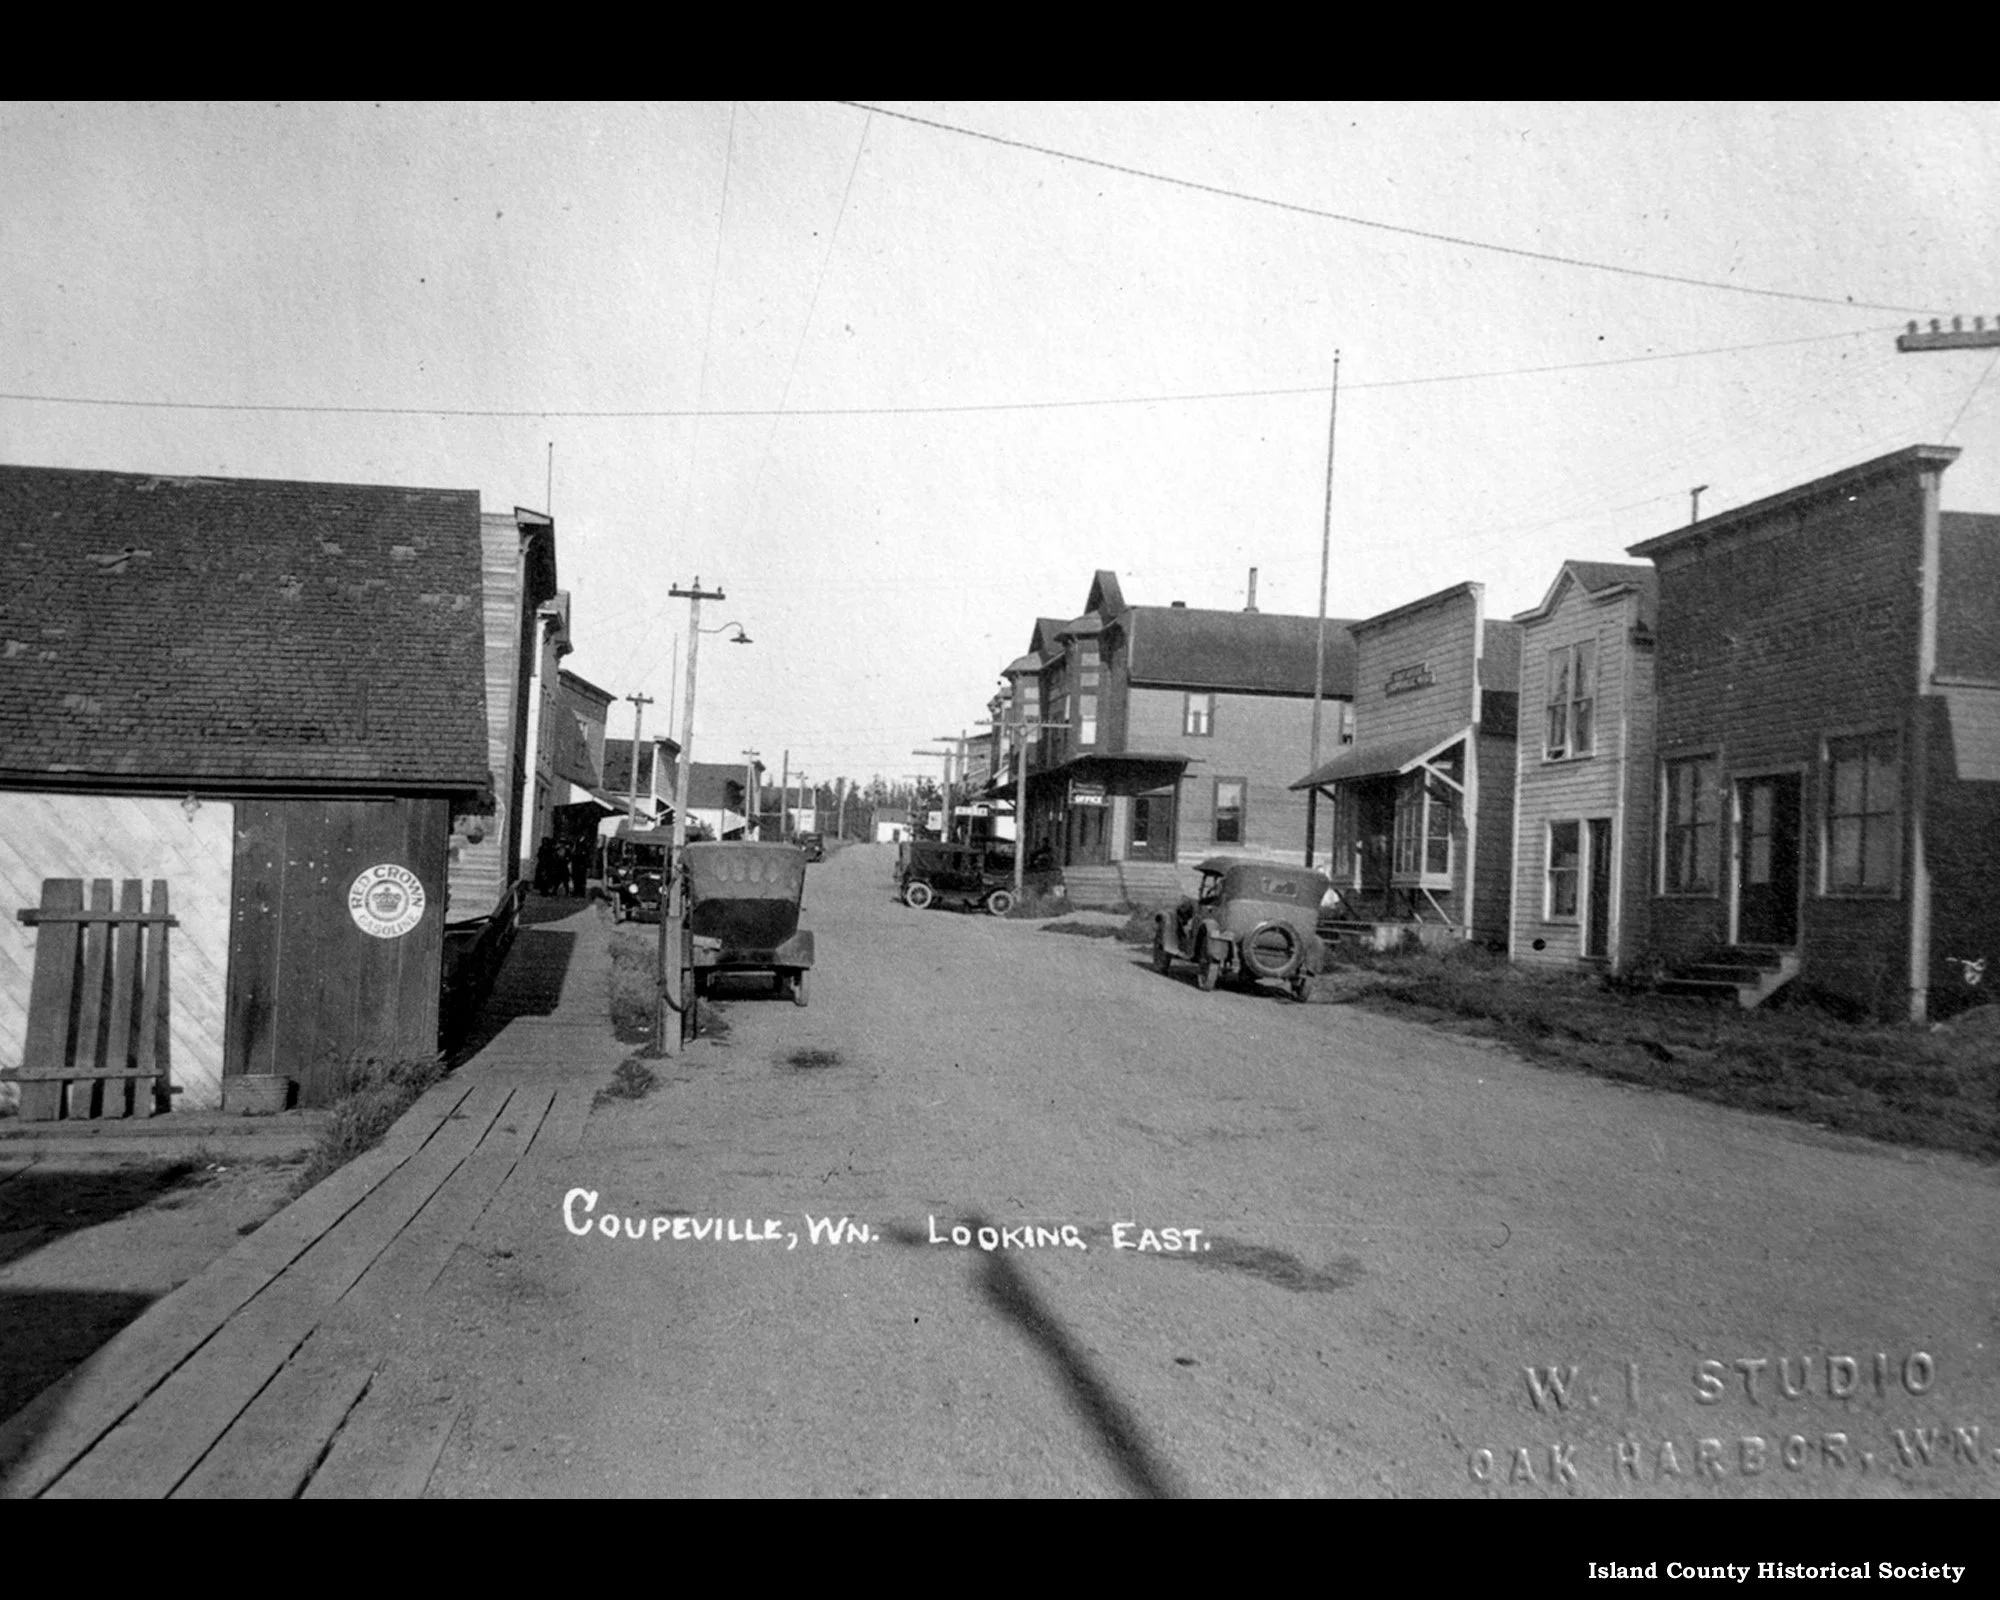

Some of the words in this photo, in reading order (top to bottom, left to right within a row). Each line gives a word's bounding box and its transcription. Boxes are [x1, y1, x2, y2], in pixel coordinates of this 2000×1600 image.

[1074, 794, 1102, 805] OFFICE
[351, 875, 371, 909] RED
[373, 866, 424, 908] CROWN
